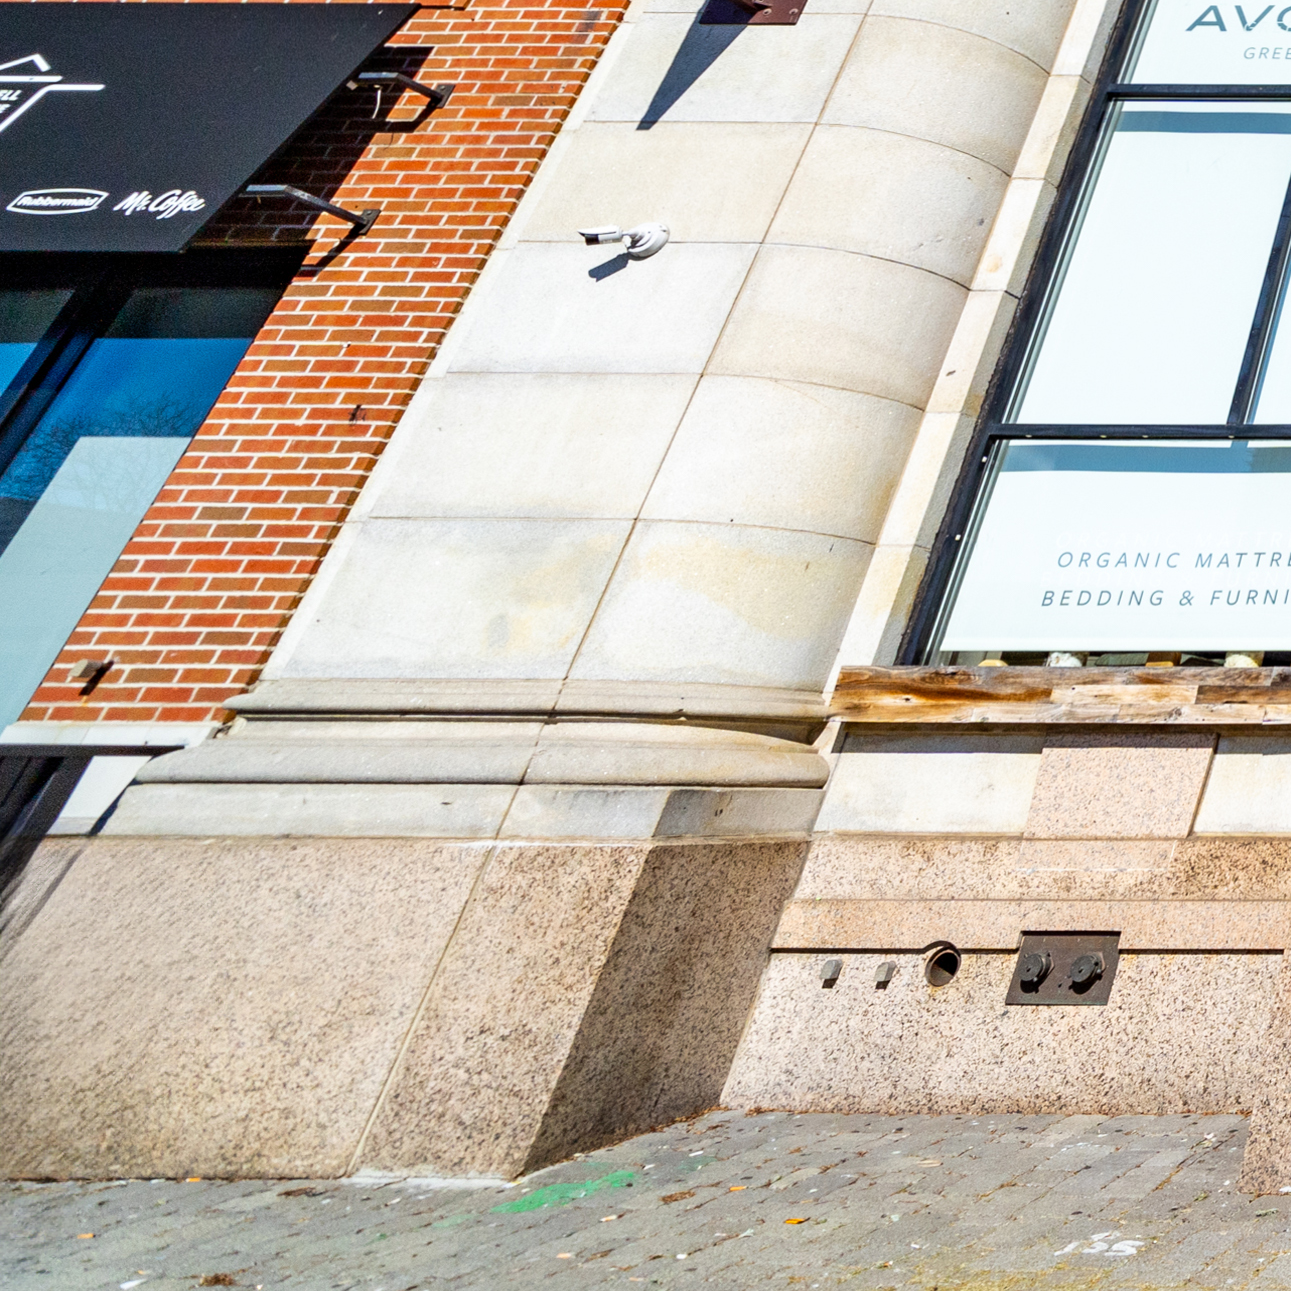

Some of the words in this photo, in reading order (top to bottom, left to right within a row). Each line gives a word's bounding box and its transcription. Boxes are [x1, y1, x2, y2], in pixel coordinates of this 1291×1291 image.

[17, 195, 99, 208] Rubbermaid
[148, 189, 206, 220] Coffee
[1056, 551, 1181, 569] ORGANIC
[1041, 589, 1165, 607] BEDDING
[1179, 590, 1195, 606] &
